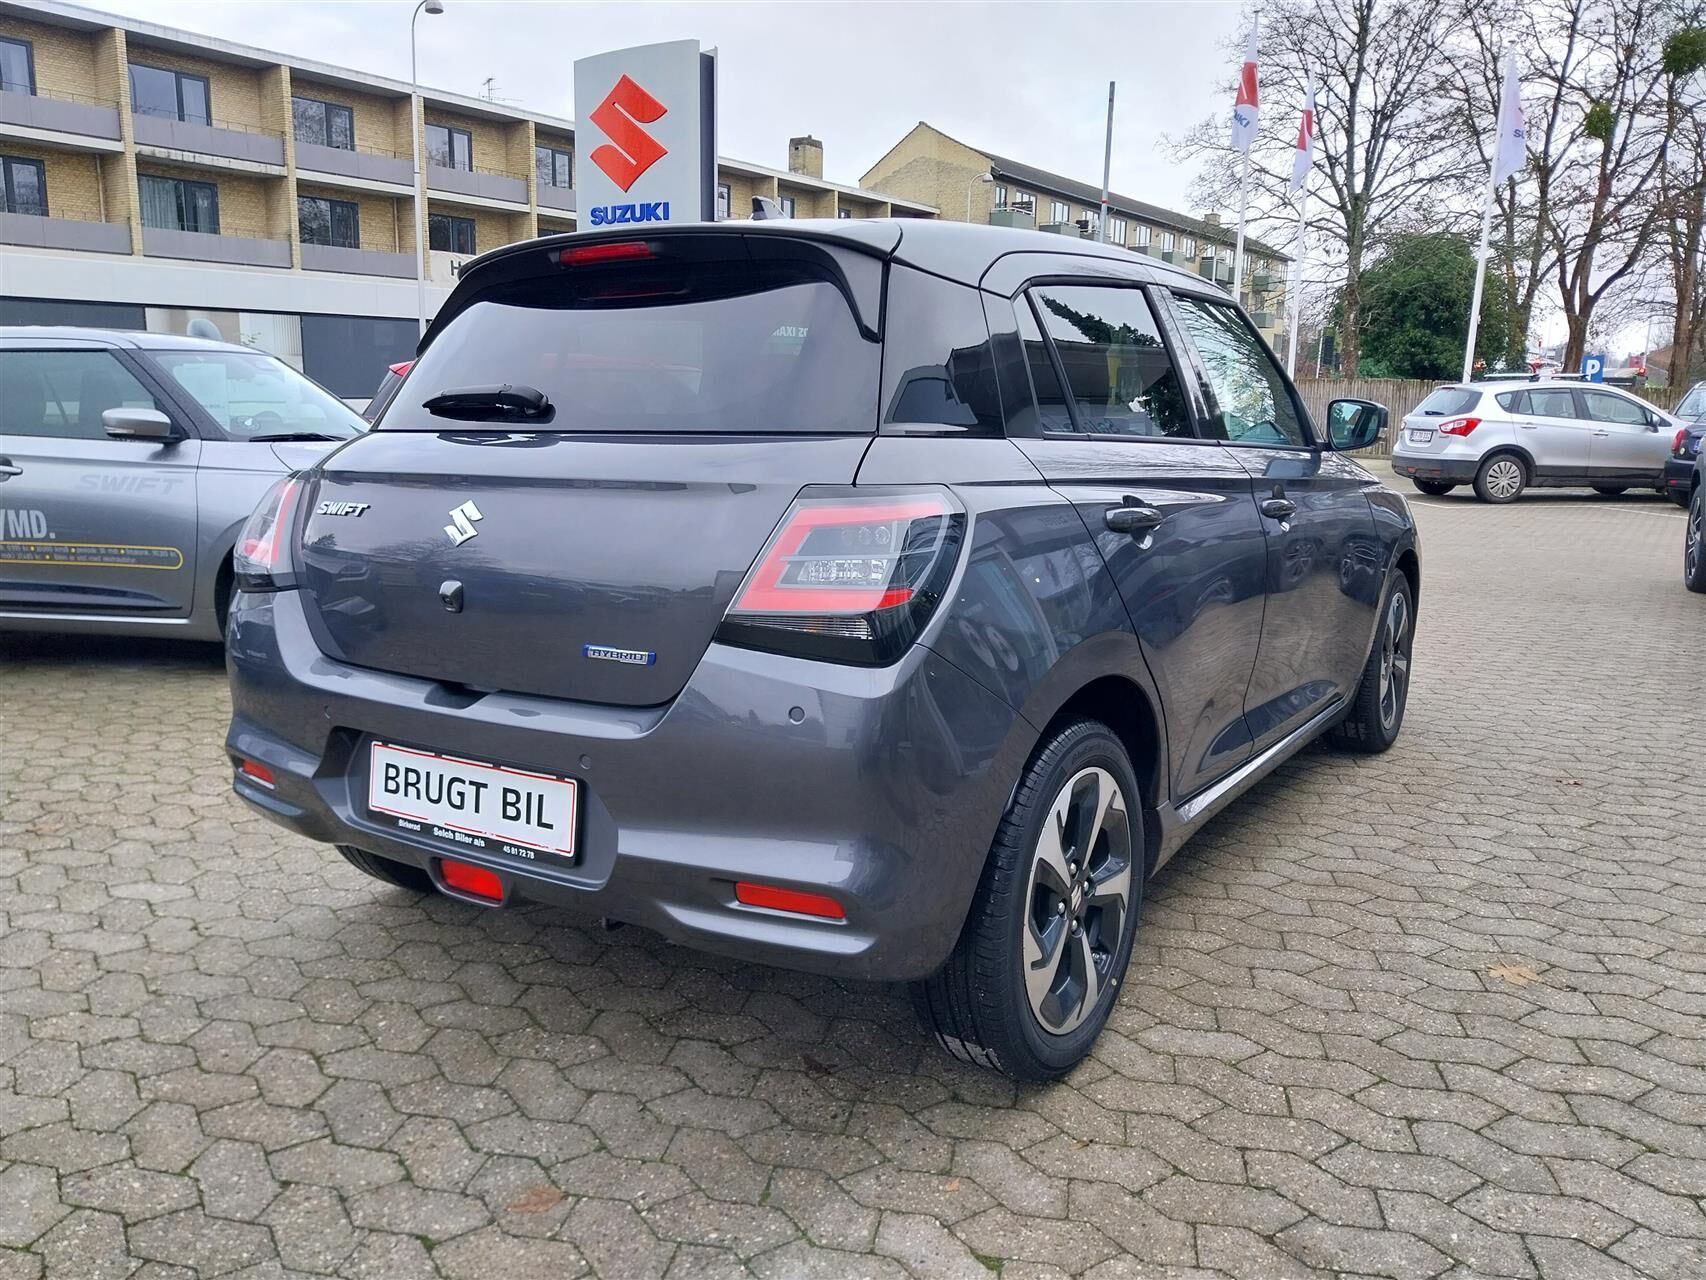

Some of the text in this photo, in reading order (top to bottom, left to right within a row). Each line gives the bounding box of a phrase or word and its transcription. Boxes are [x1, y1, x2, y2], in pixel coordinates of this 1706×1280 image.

[590, 202, 669, 226] SUZUKI
[1586, 359, 1601, 381] P
[75, 474, 184, 496] SWIFT
[316, 500, 371, 518] SWIFT
[592, 648, 644, 661] HYBRID
[384, 762, 554, 830] BRUGT BIL
